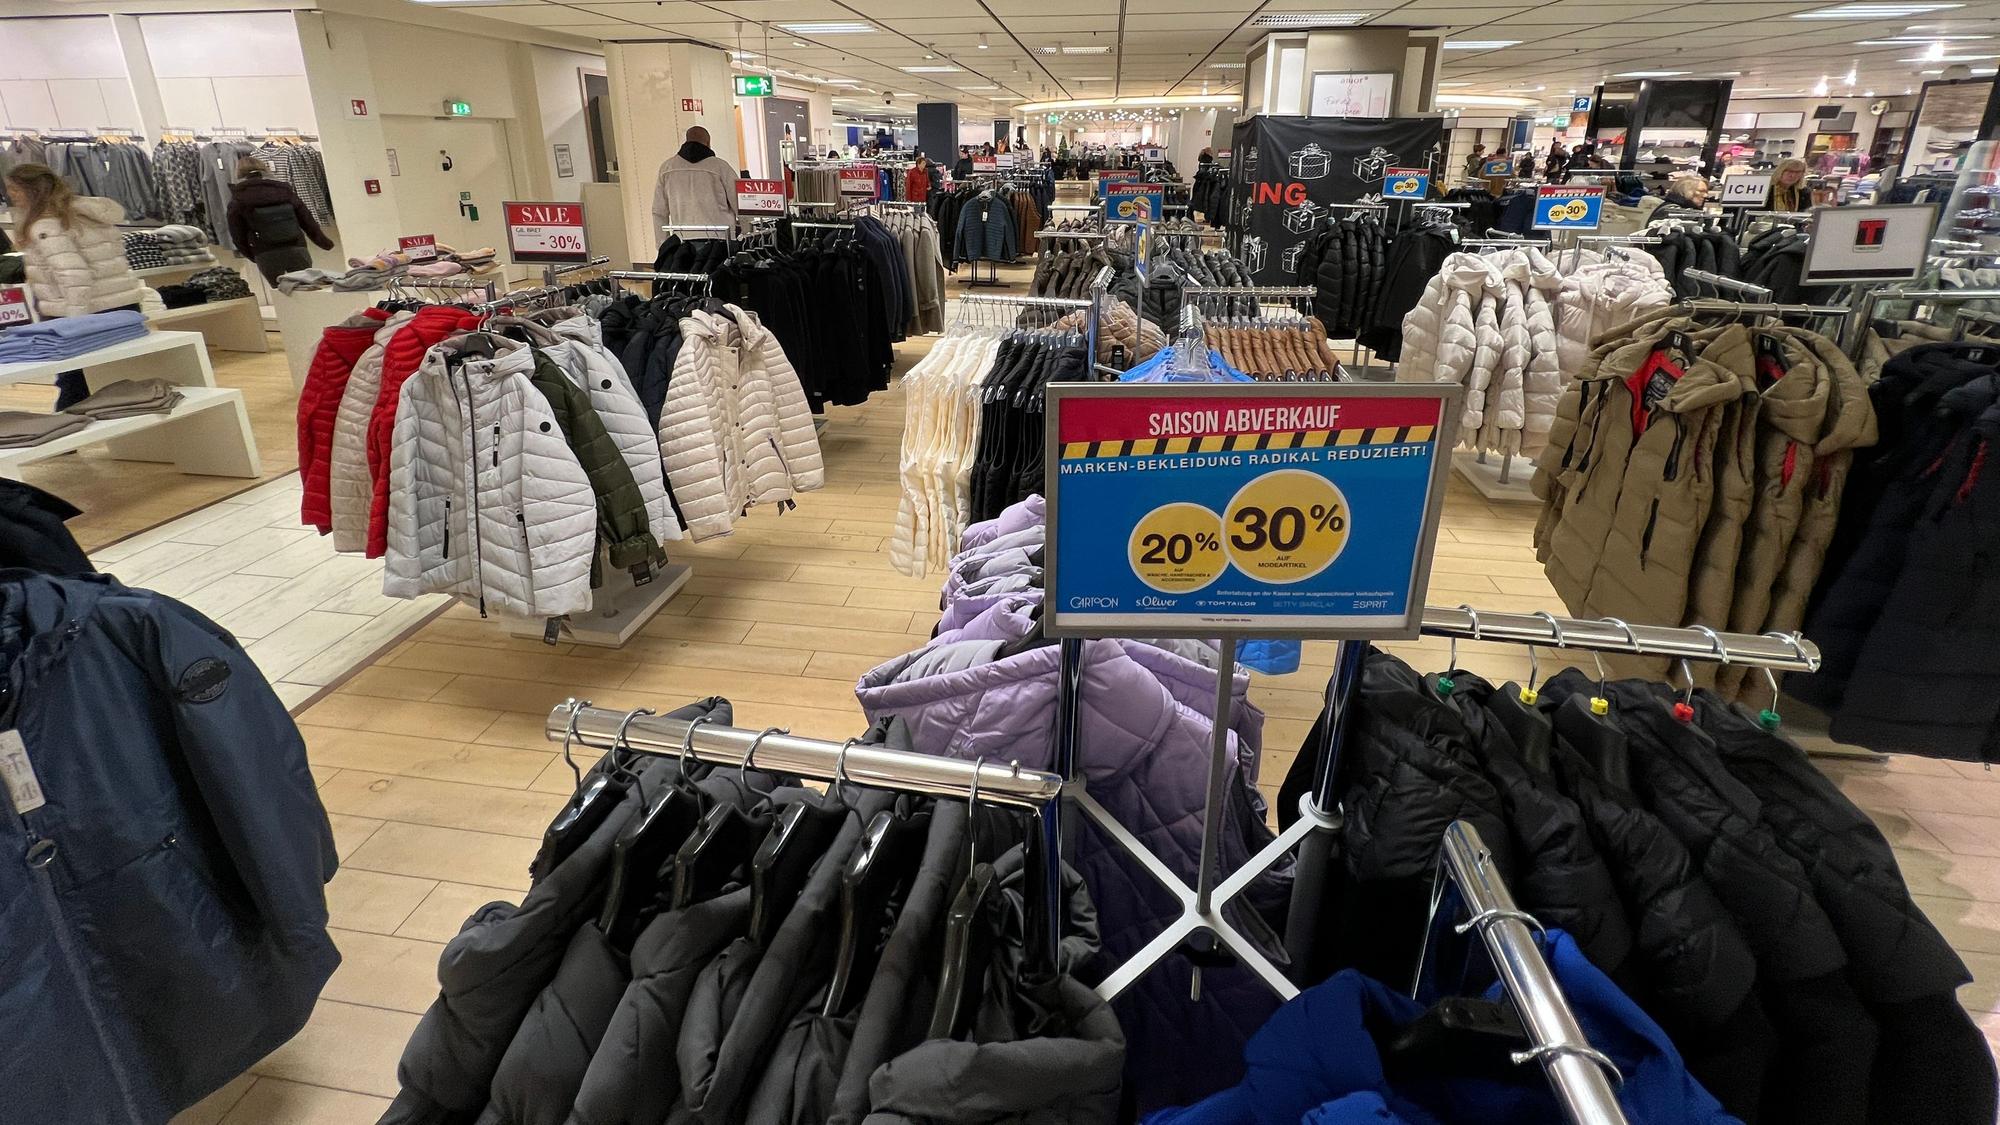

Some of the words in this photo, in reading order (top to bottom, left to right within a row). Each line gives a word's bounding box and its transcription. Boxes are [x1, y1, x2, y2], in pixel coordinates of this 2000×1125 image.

[846, 170, 869, 178] SALE
[745, 182, 776, 193] SALE
[1728, 184, 1764, 194] ICHI
[521, 207, 570, 222] SALE
[1566, 205, 1587, 215] 30%
[406, 237, 430, 247] SALE
[549, 235, 581, 250] 30%
[1149, 410, 1219, 436] SAISON
[1224, 405, 1341, 432] ABVERKAUF
[1060, 455, 1242, 475] MARKEN-BEKLEIDUNG
[1249, 452, 1320, 465] RADIKAL
[1327, 445, 1427, 461] REDUZIERT!
[1140, 532, 1219, 565] 20%
[1230, 504, 1345, 552] 30%
[1070, 596, 1119, 609] CARTOON
[1136, 596, 1178, 607] s.Oliver
[1352, 601, 1388, 609] ESPRIT
